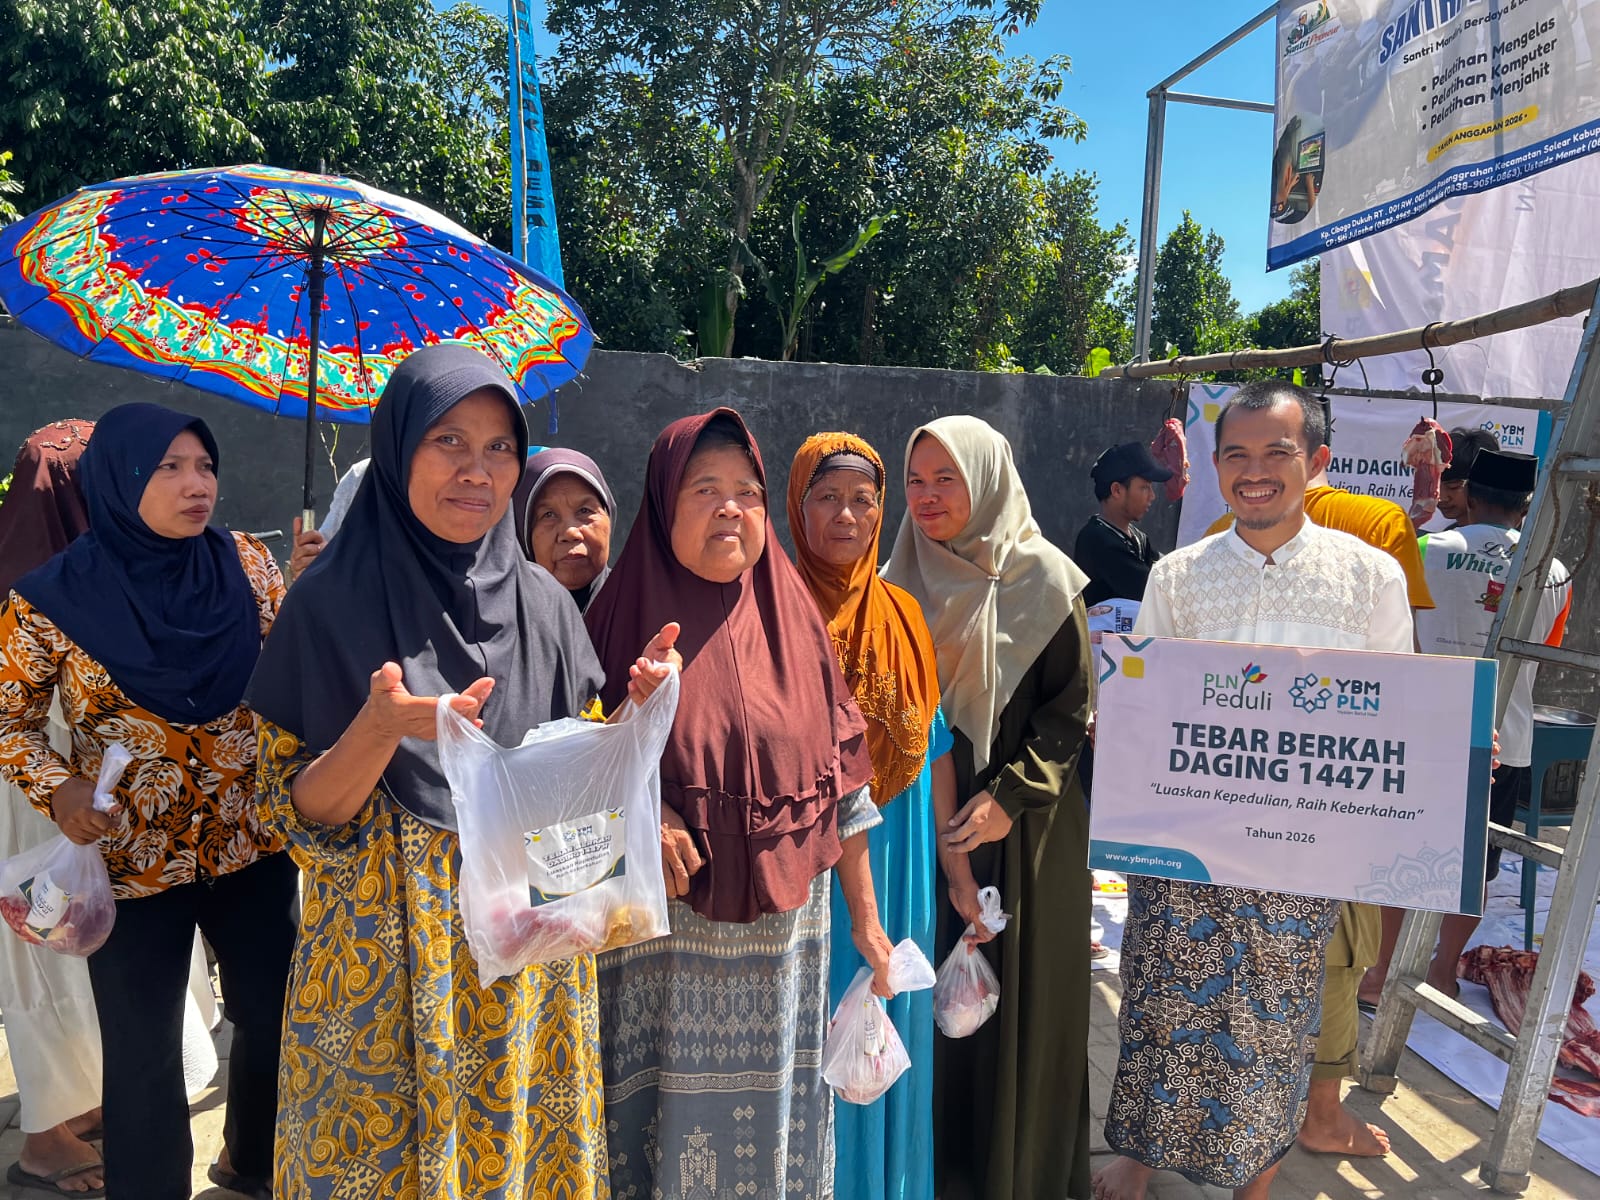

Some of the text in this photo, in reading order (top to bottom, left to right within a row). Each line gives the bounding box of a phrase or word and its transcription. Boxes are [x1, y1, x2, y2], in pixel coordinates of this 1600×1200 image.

[1403, 46, 1434, 64] Santri
[1464, 6, 1509, 30] Berdaya
[1432, 18, 1556, 90] Pelatihan Mengelas
[1431, 39, 1557, 109] Pelatihan Komputer
[1431, 62, 1550, 128] Pelatihan Menjahit
[1454, 121, 1504, 142] ANGGARAN
[1504, 114, 1523, 127] 2026
[1555, 144, 1586, 161] Memet
[1352, 213, 1373, 227] Dukuh
[1495, 150, 1542, 171] Kecamatan
[1543, 138, 1572, 153] Solear
[1501, 435, 1524, 446] PLN
[1502, 424, 1525, 435] YBM
[1357, 459, 1416, 477] DAGIN
[1368, 483, 1395, 498] Raih
[1446, 552, 1504, 576] White
[1203, 672, 1239, 690] PLN
[1335, 678, 1381, 696] YBM
[1202, 687, 1272, 712] Peduli
[1336, 694, 1380, 711] PLN
[1171, 721, 1406, 766] TEBAR BERKAH
[1168, 748, 1406, 795] DAGING 1447 H
[1150, 782, 1425, 821] “Luaskan Kepedulian, Raih Keberkahan”
[1245, 826, 1316, 844] Tahun 2026
[1105, 852, 1183, 870] www.ybmpln.org
